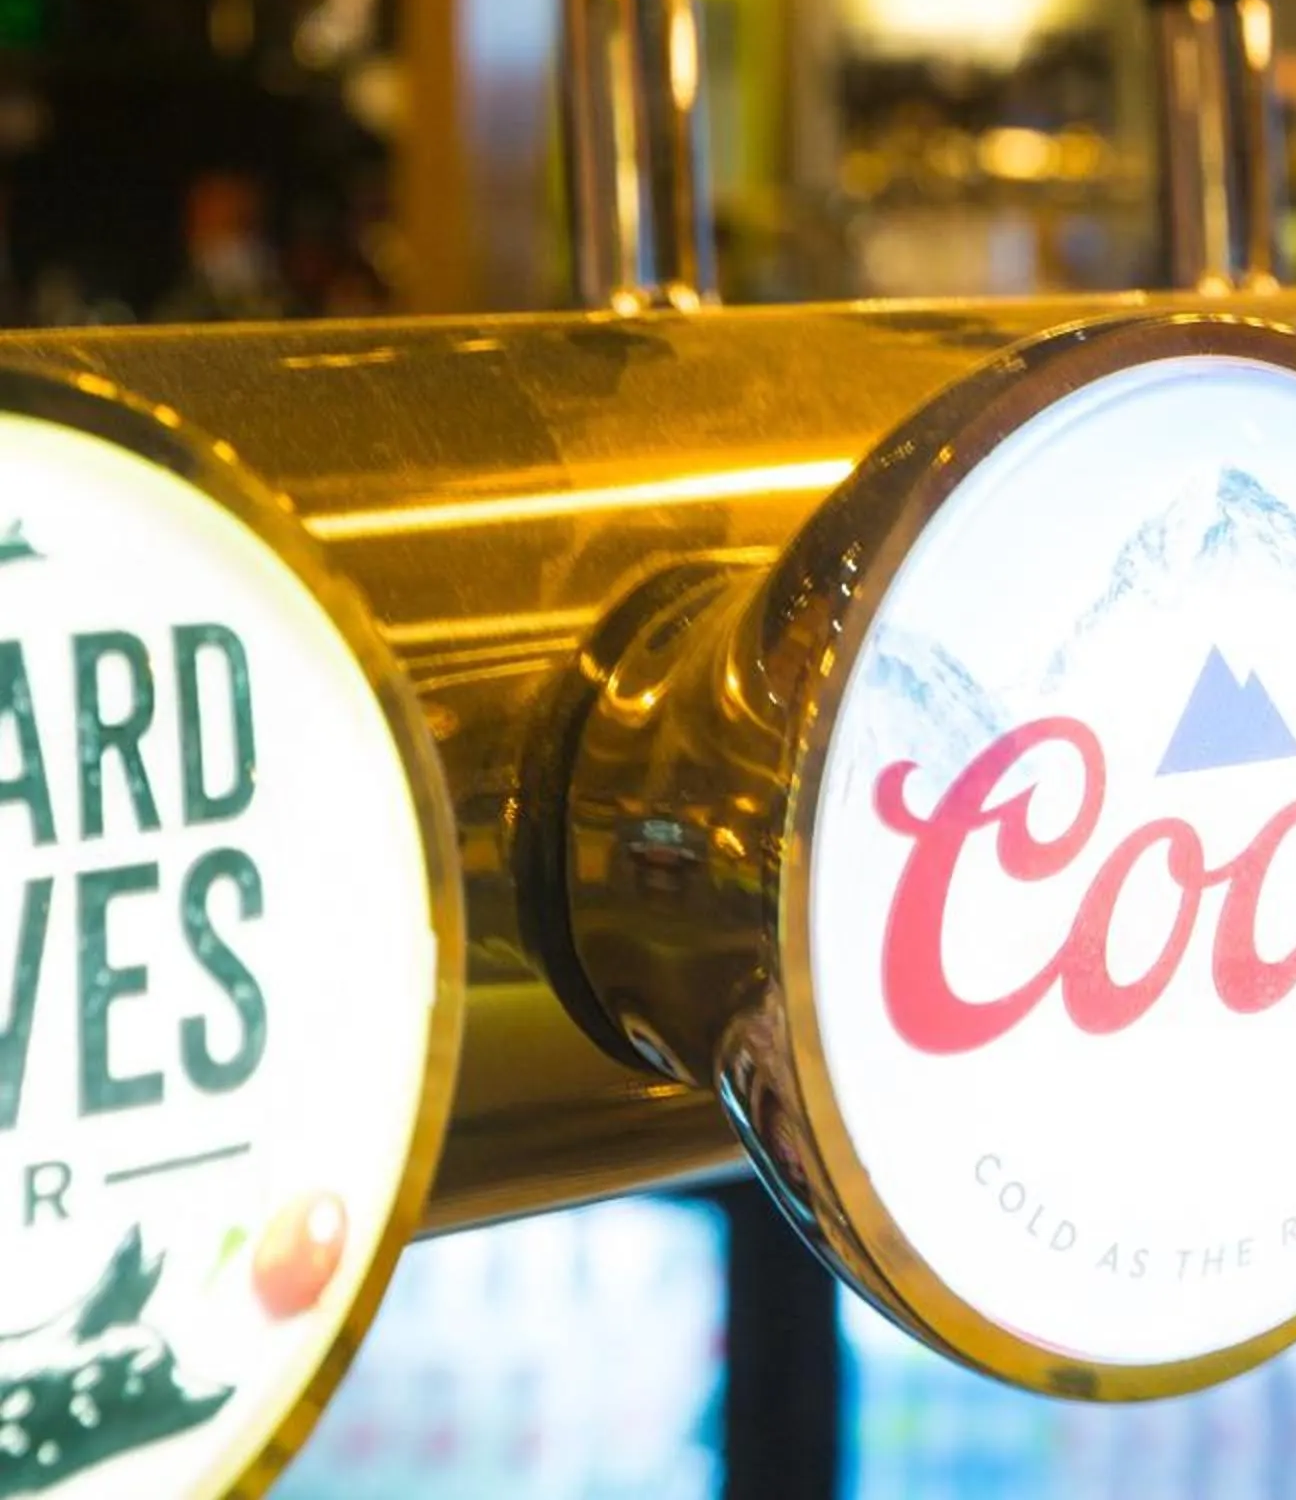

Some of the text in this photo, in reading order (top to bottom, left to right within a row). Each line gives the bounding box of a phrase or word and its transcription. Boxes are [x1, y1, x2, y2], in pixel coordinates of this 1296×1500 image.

[974, 1152, 1077, 1253] COLD
[1095, 1242, 1151, 1280] AS
[1175, 1237, 1257, 1282] THE
